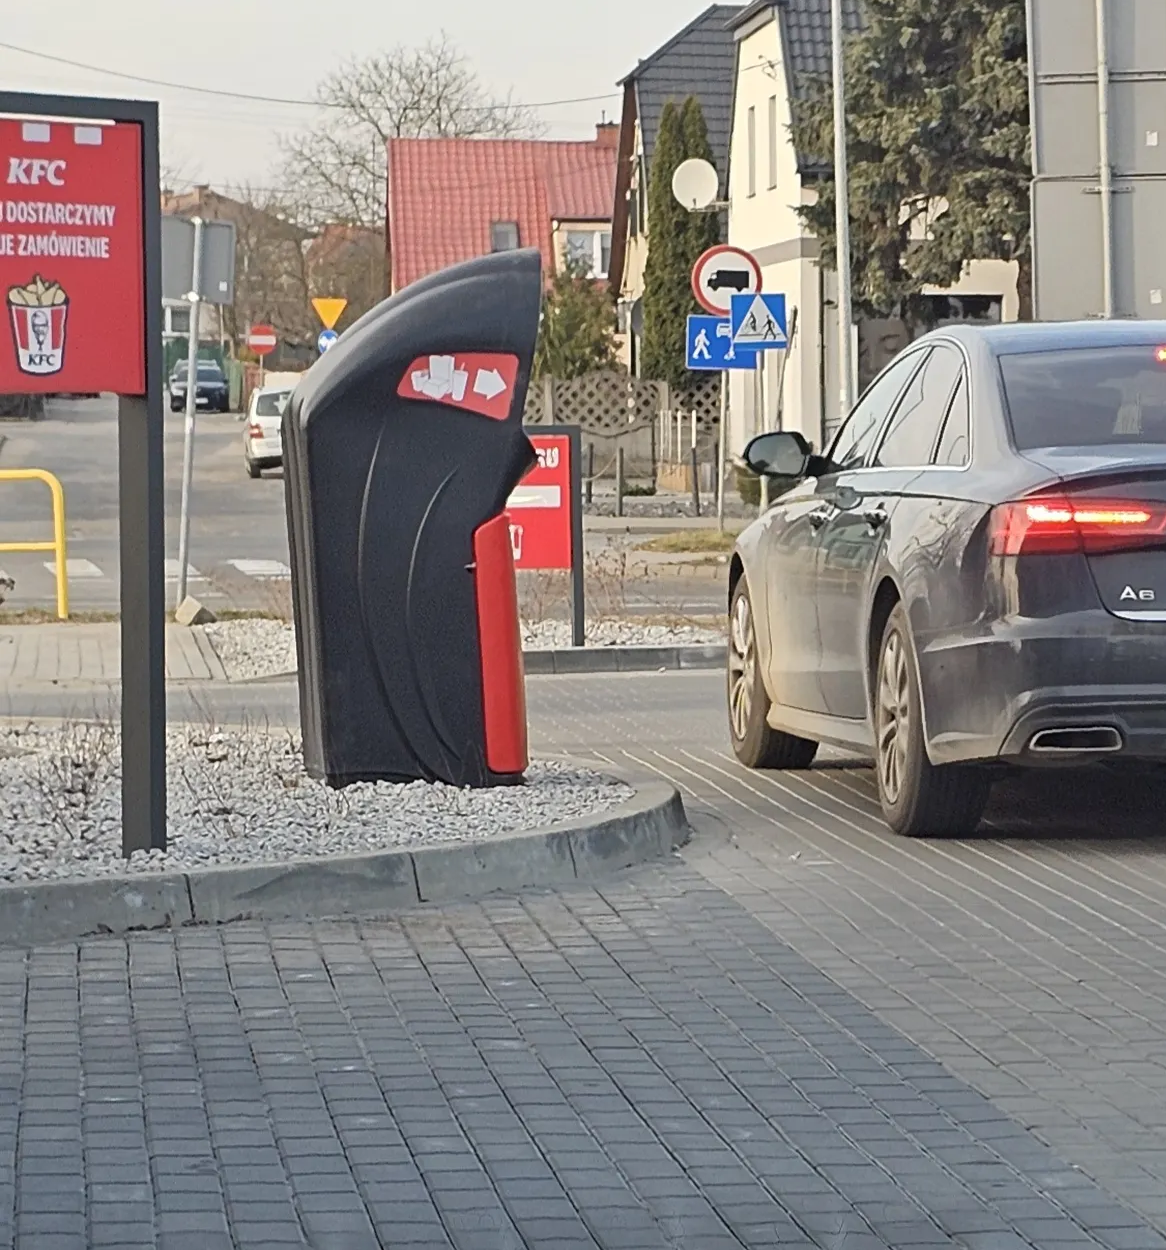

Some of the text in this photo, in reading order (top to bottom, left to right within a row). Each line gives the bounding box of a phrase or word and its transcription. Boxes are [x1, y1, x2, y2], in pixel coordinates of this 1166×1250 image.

[7, 157, 66, 186] KFC
[6, 200, 116, 227] DOSTARCZYMY
[18, 230, 110, 259] ZAMÓWIENIE
[28, 354, 55, 367] KFC
[1120, 585, 1155, 601] A6
